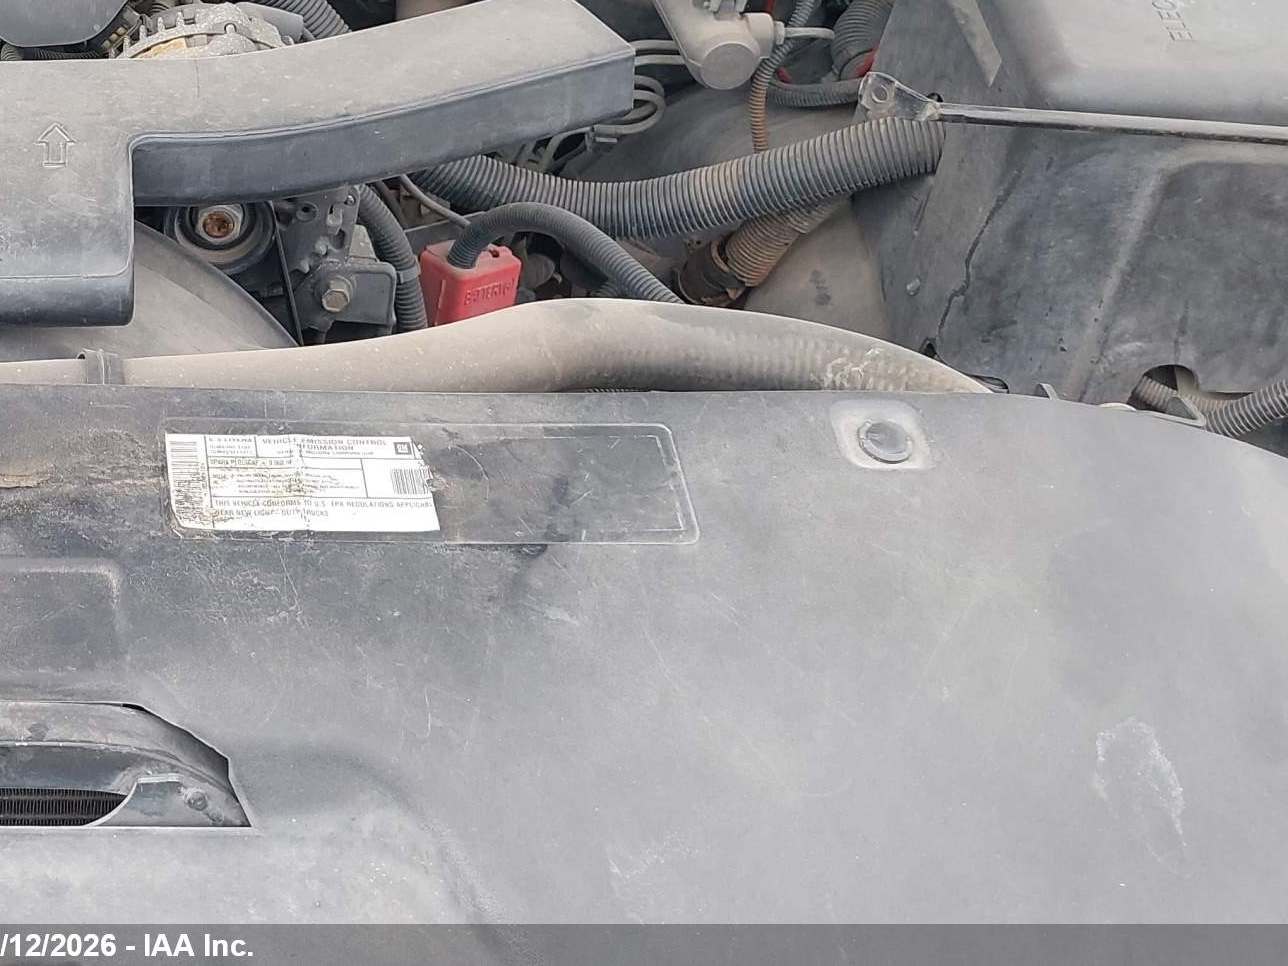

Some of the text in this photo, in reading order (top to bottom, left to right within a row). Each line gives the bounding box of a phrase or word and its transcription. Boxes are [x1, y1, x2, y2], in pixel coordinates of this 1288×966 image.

[261, 437, 297, 445] VEHICLE
[301, 437, 344, 445] EMISSION
[295, 443, 355, 451] NFORMATION
[215, 499, 231, 507] THIS
[233, 499, 259, 507] VEHICLE
[262, 499, 302, 507] CONFORMS
[236, 509, 252, 517] NEW
